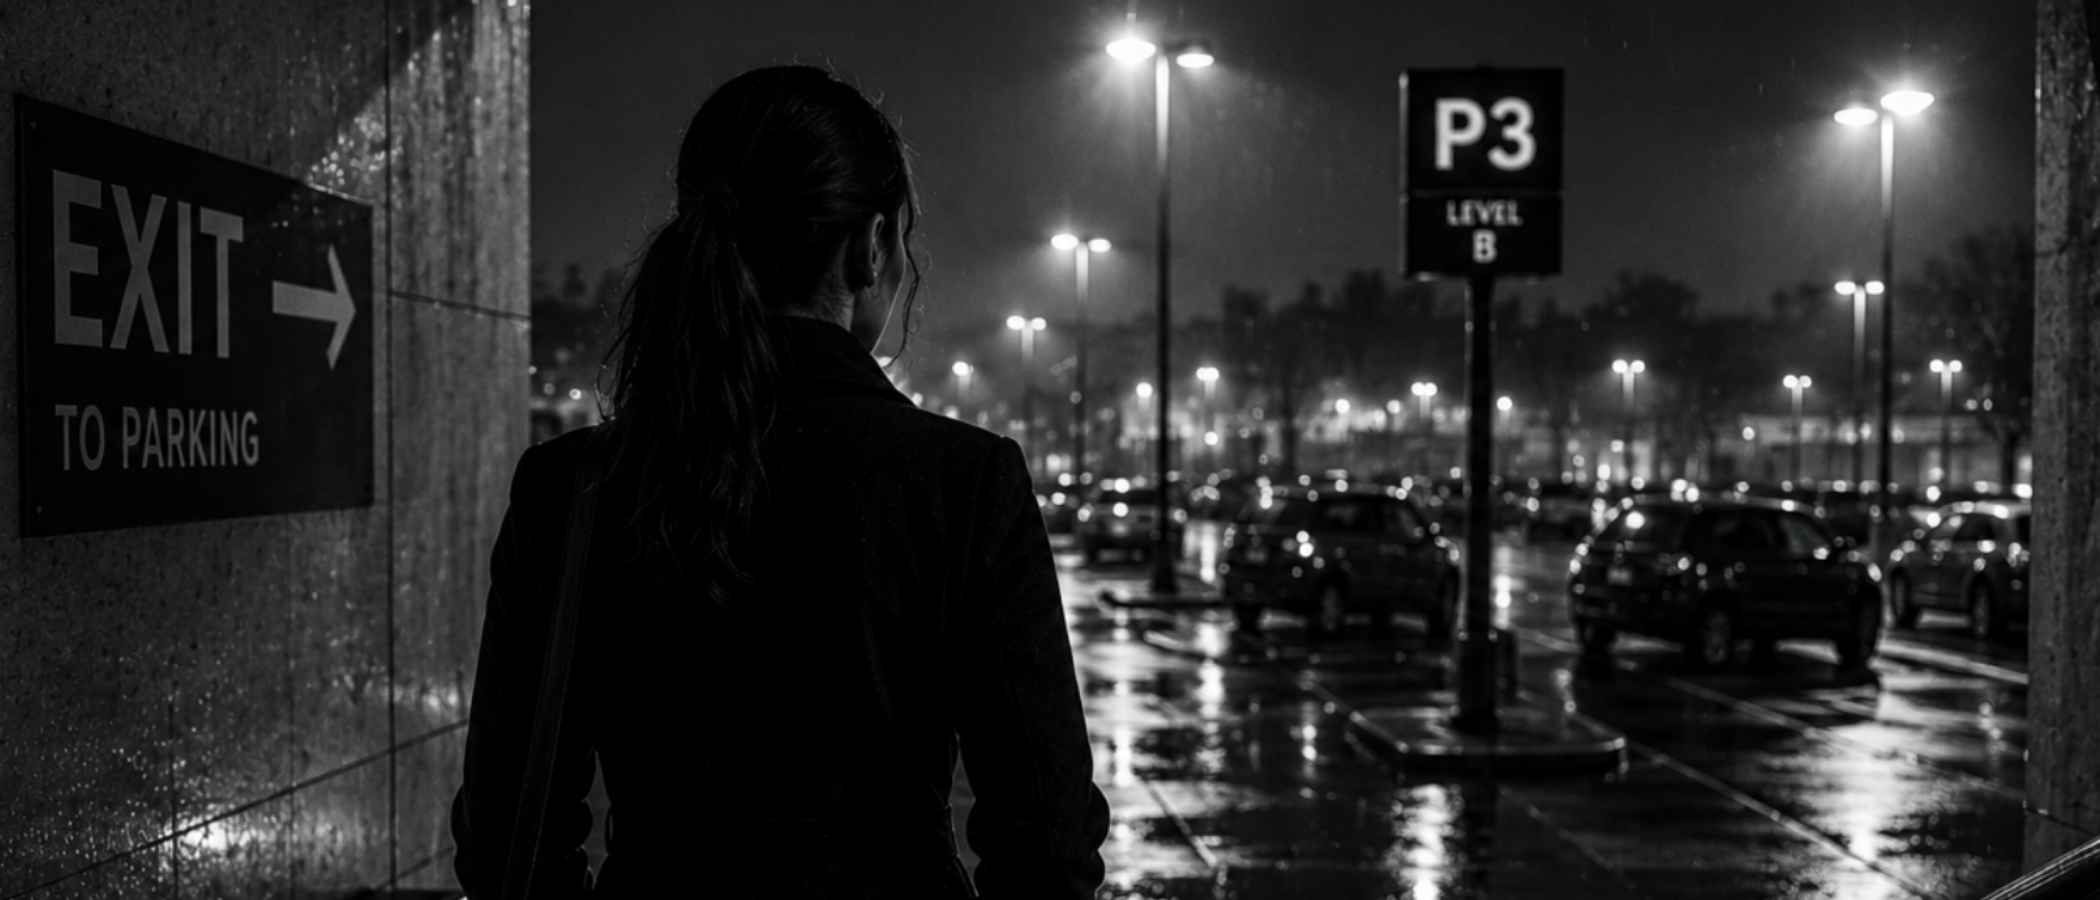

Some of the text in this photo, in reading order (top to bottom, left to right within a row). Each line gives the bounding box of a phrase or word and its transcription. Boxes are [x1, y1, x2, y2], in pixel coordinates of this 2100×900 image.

[1434, 95, 1537, 172] P3
[1446, 198, 1524, 227] LEVEL
[1471, 228, 1498, 264] B
[52, 168, 244, 360] EXIT
[55, 404, 259, 471] TO PARKING
